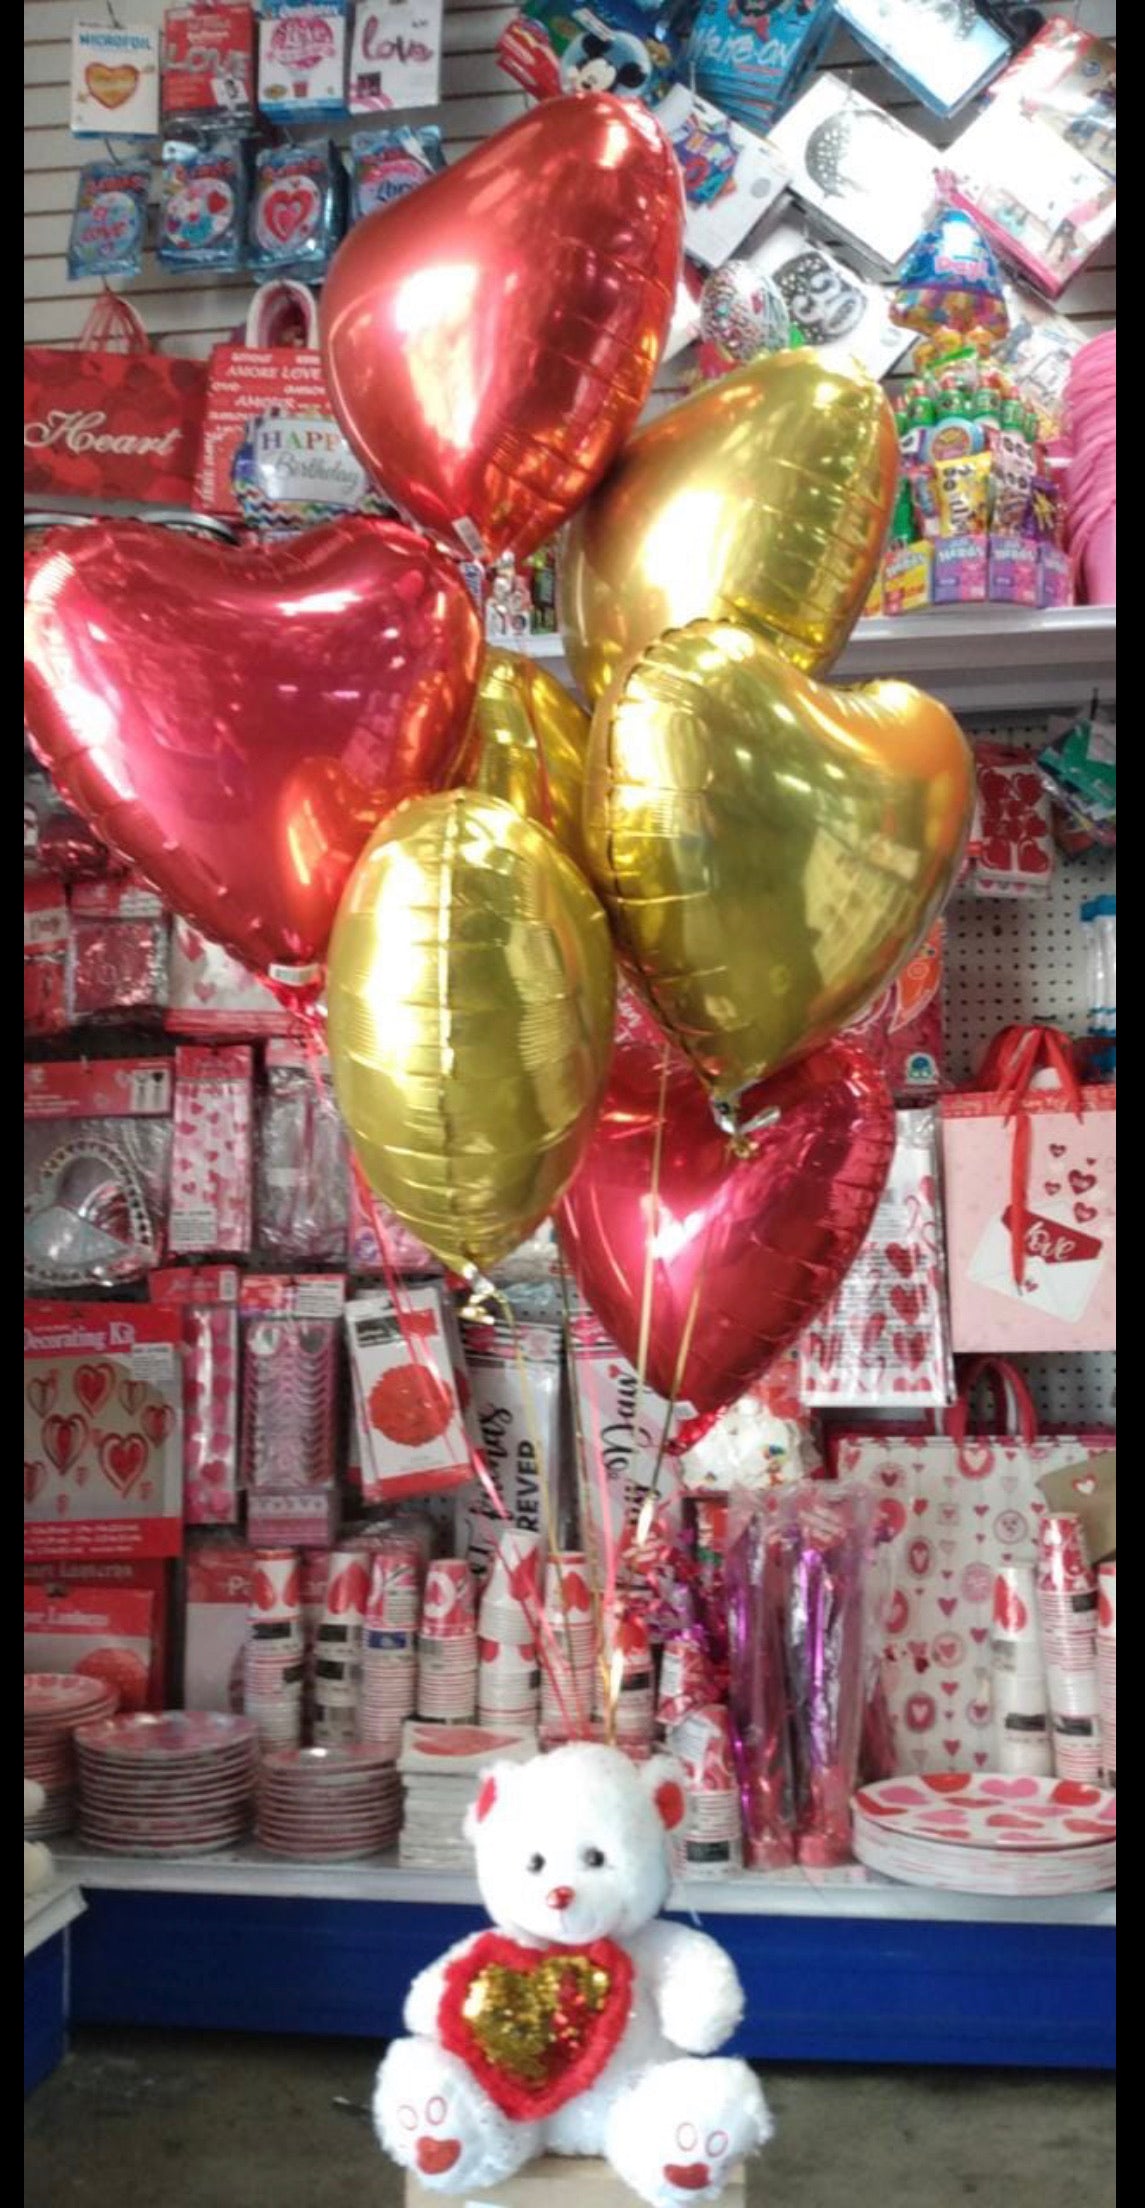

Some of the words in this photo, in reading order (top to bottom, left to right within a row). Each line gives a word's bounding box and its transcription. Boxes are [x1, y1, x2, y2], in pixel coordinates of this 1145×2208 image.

[79, 32, 151, 50] MICROFOIL
[362, 14, 433, 64] love
[791, 271, 866, 335] 30
[281, 365, 323, 380] LOVE
[24, 409, 183, 456] Heart
[261, 430, 341, 450] HAPP
[272, 450, 362, 495] Birthday
[1026, 1221, 1076, 1262] love
[516, 1441, 540, 1532] REVER
